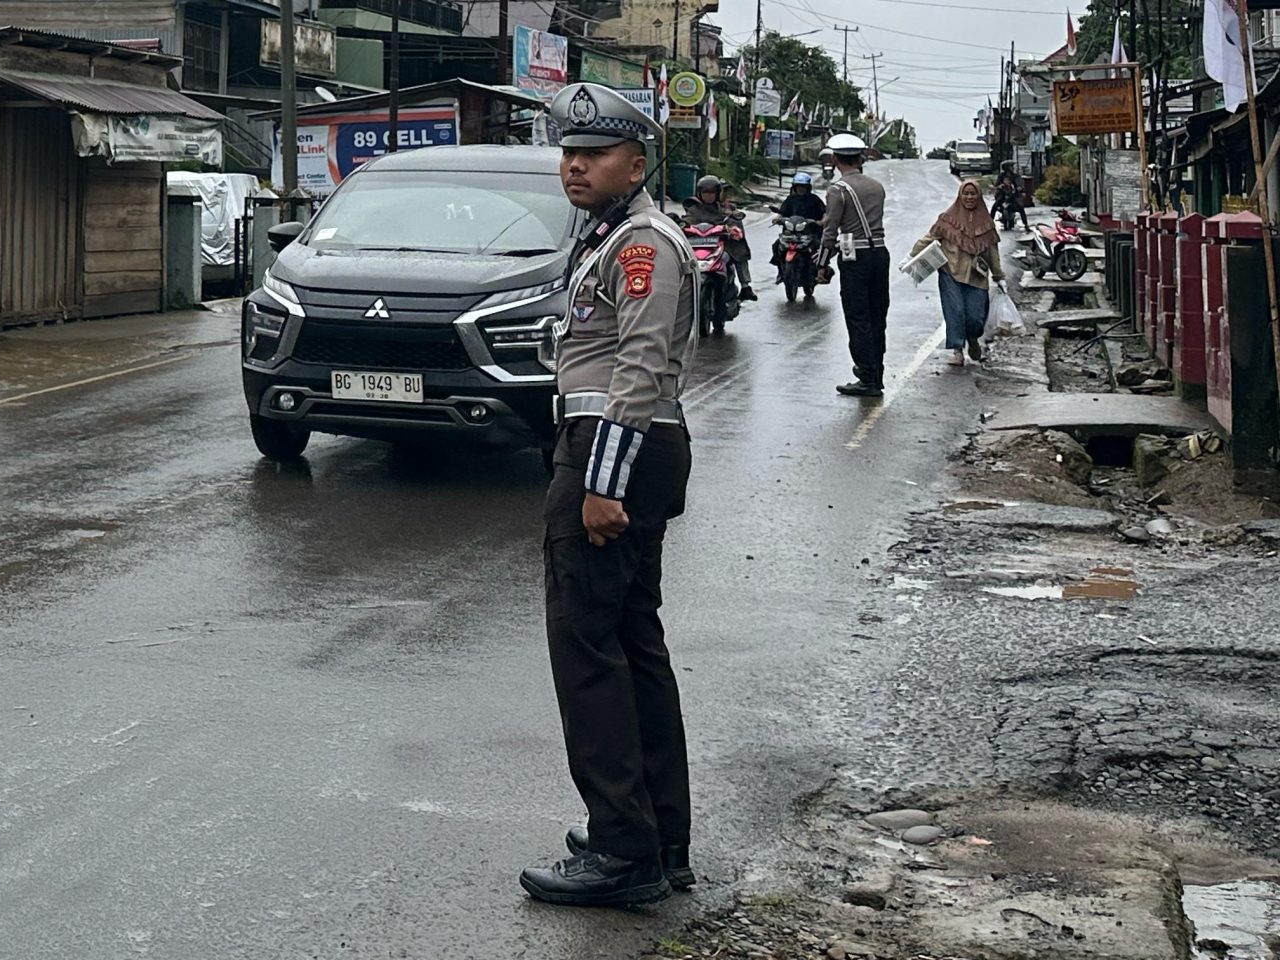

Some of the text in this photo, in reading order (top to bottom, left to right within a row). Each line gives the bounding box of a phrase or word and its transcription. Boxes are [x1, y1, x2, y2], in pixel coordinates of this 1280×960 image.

[620, 92, 651, 103] MASARAN
[353, 131, 377, 148] 89
[335, 373, 420, 393] BG 1949 BU
